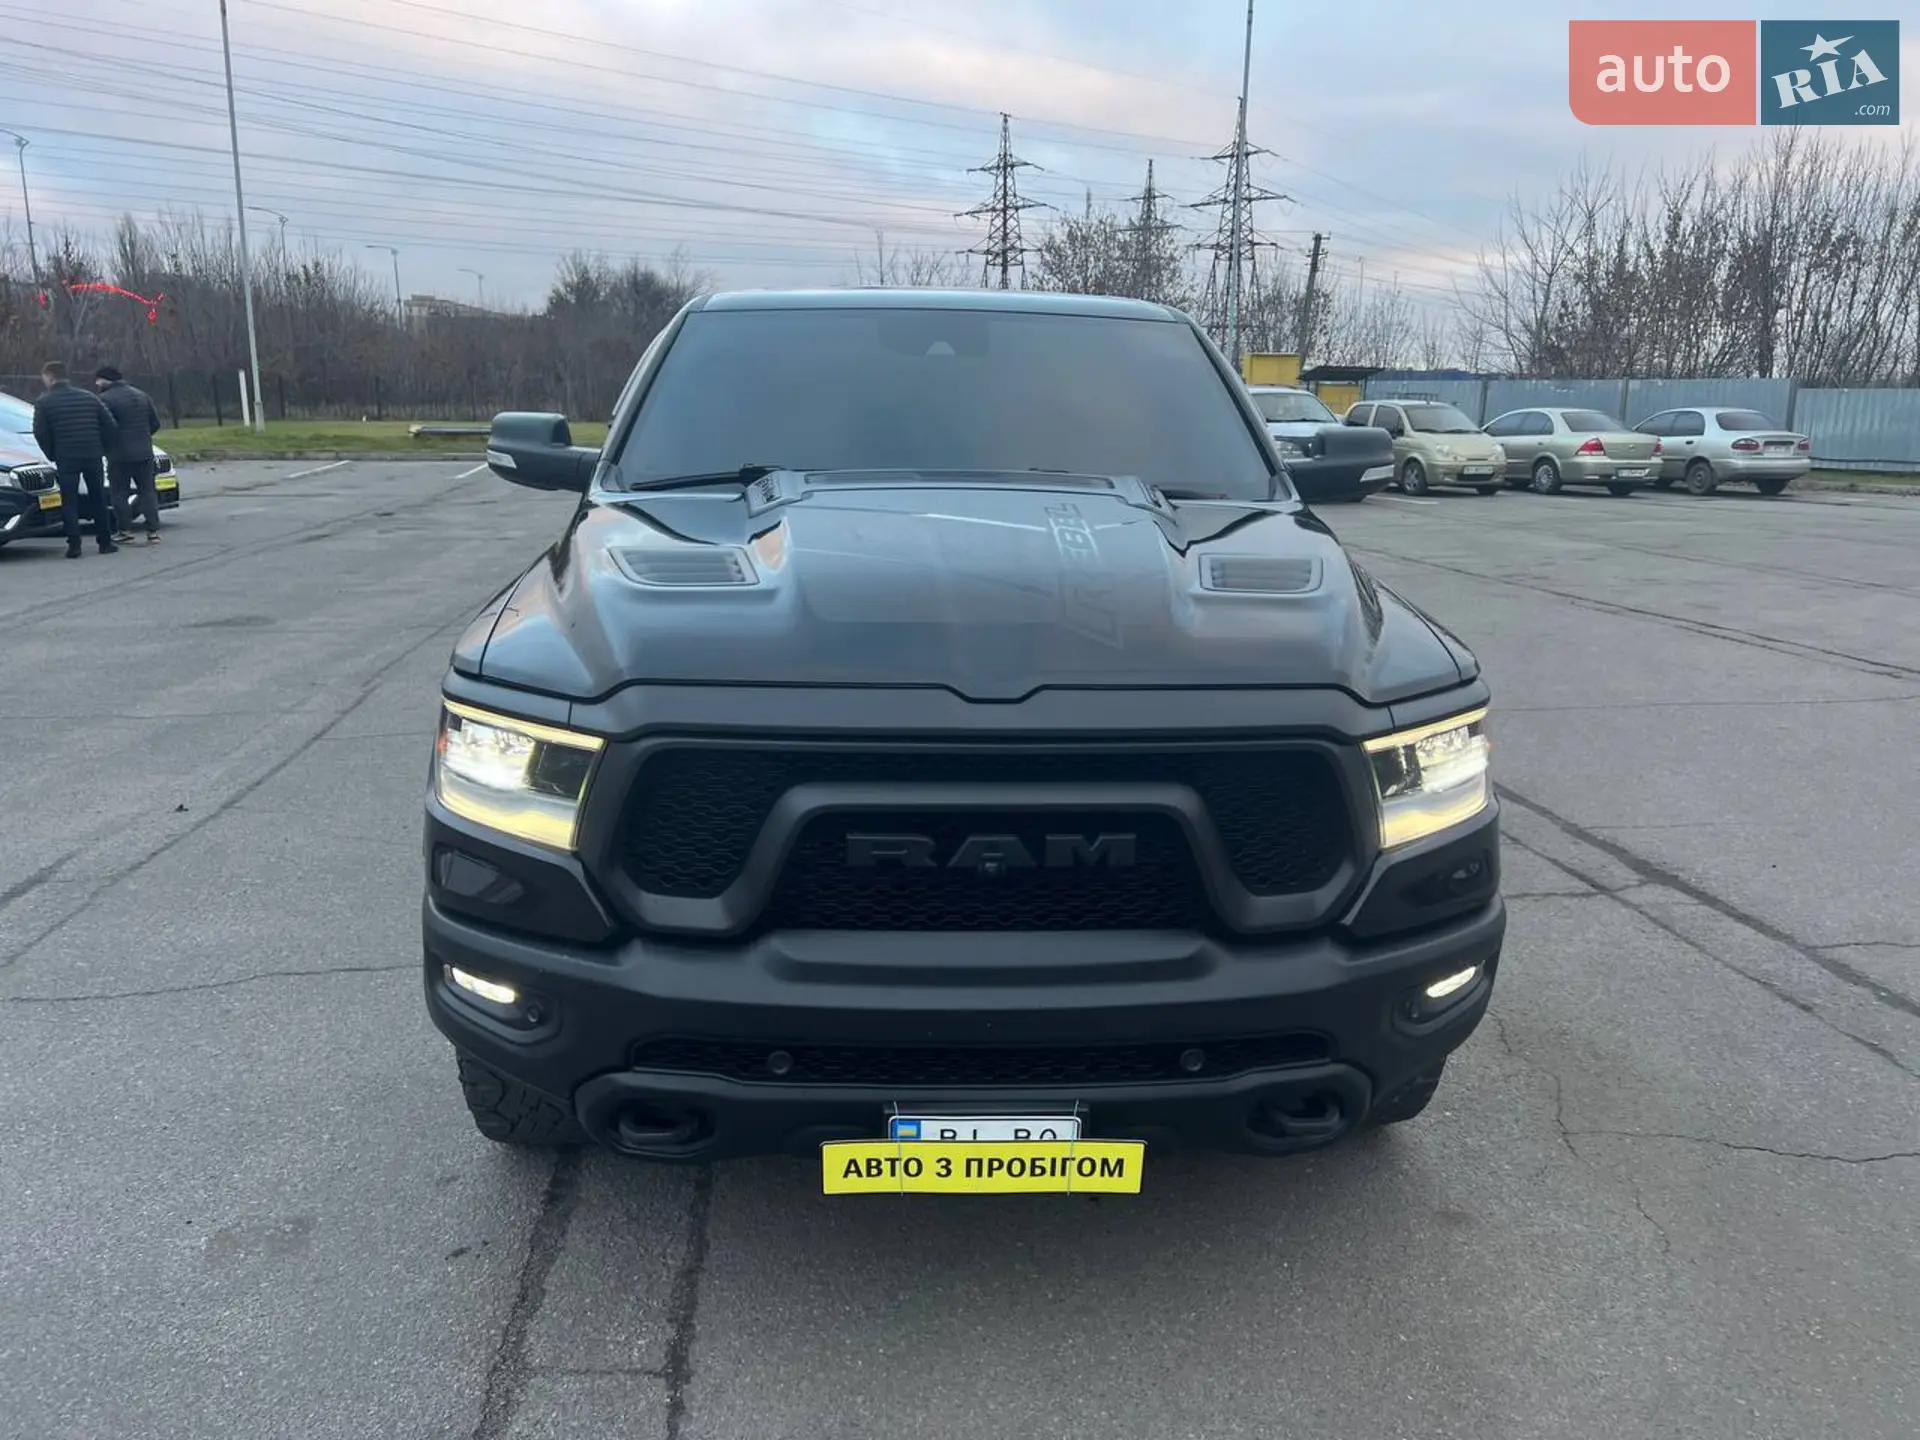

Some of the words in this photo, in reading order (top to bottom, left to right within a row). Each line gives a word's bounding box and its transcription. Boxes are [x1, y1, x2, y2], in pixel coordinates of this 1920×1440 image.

[845, 833, 1137, 867] RAM
[842, 1157, 923, 1178] АВТО
[964, 1157, 1125, 1178] ПРОБІГОМ
